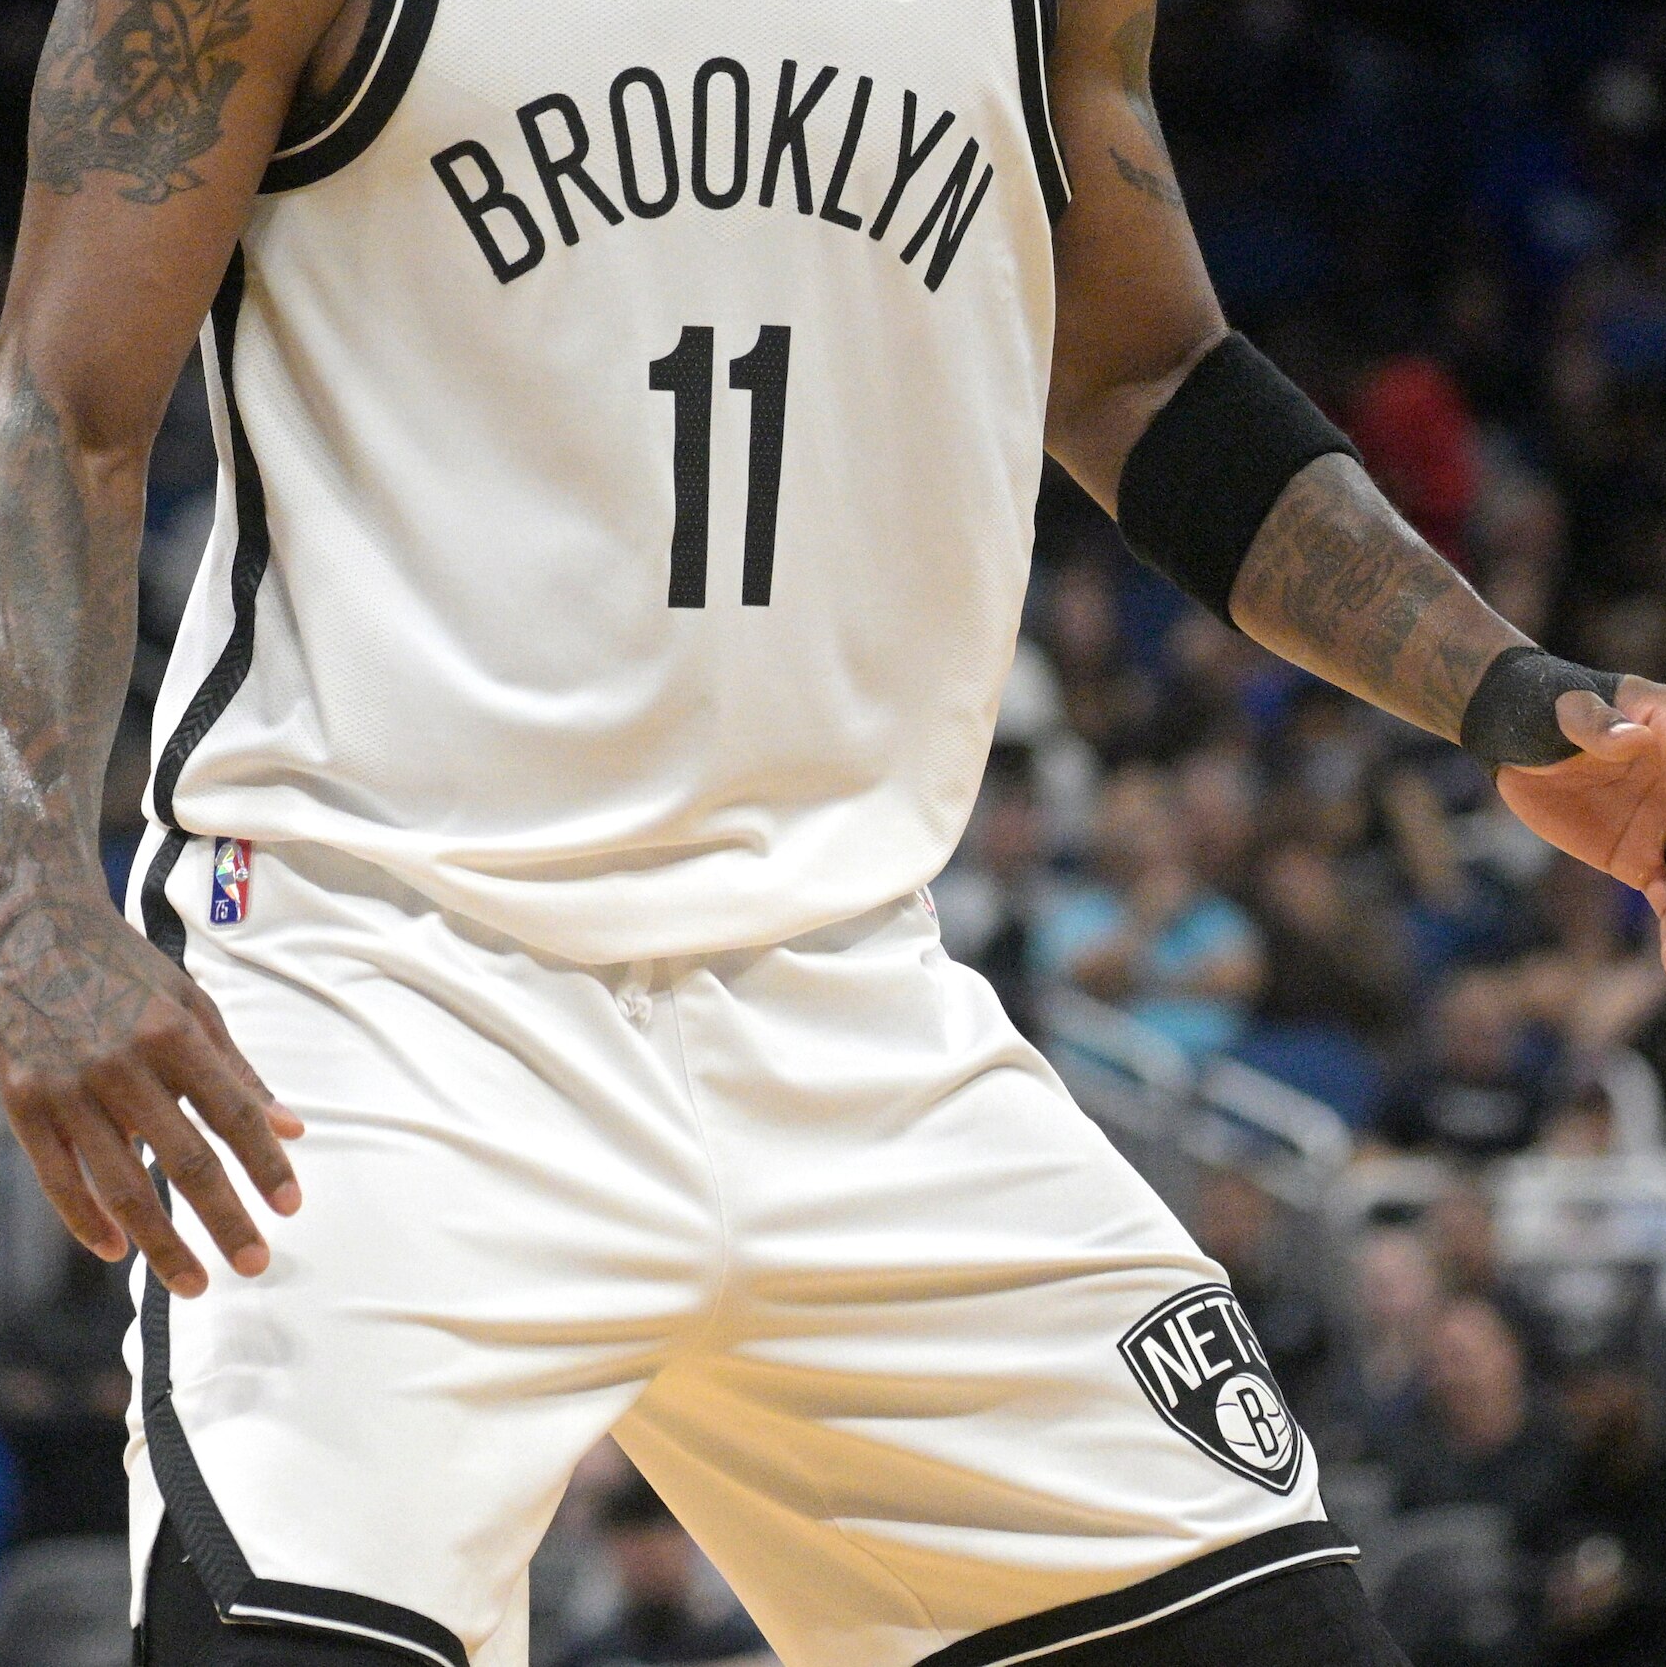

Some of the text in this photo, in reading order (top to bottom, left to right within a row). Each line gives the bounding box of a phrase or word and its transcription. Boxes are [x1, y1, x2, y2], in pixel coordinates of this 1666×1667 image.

[430, 56, 994, 293] BROOKLYN
[648, 324, 791, 610] 11
[1236, 1387, 1280, 1459] B
